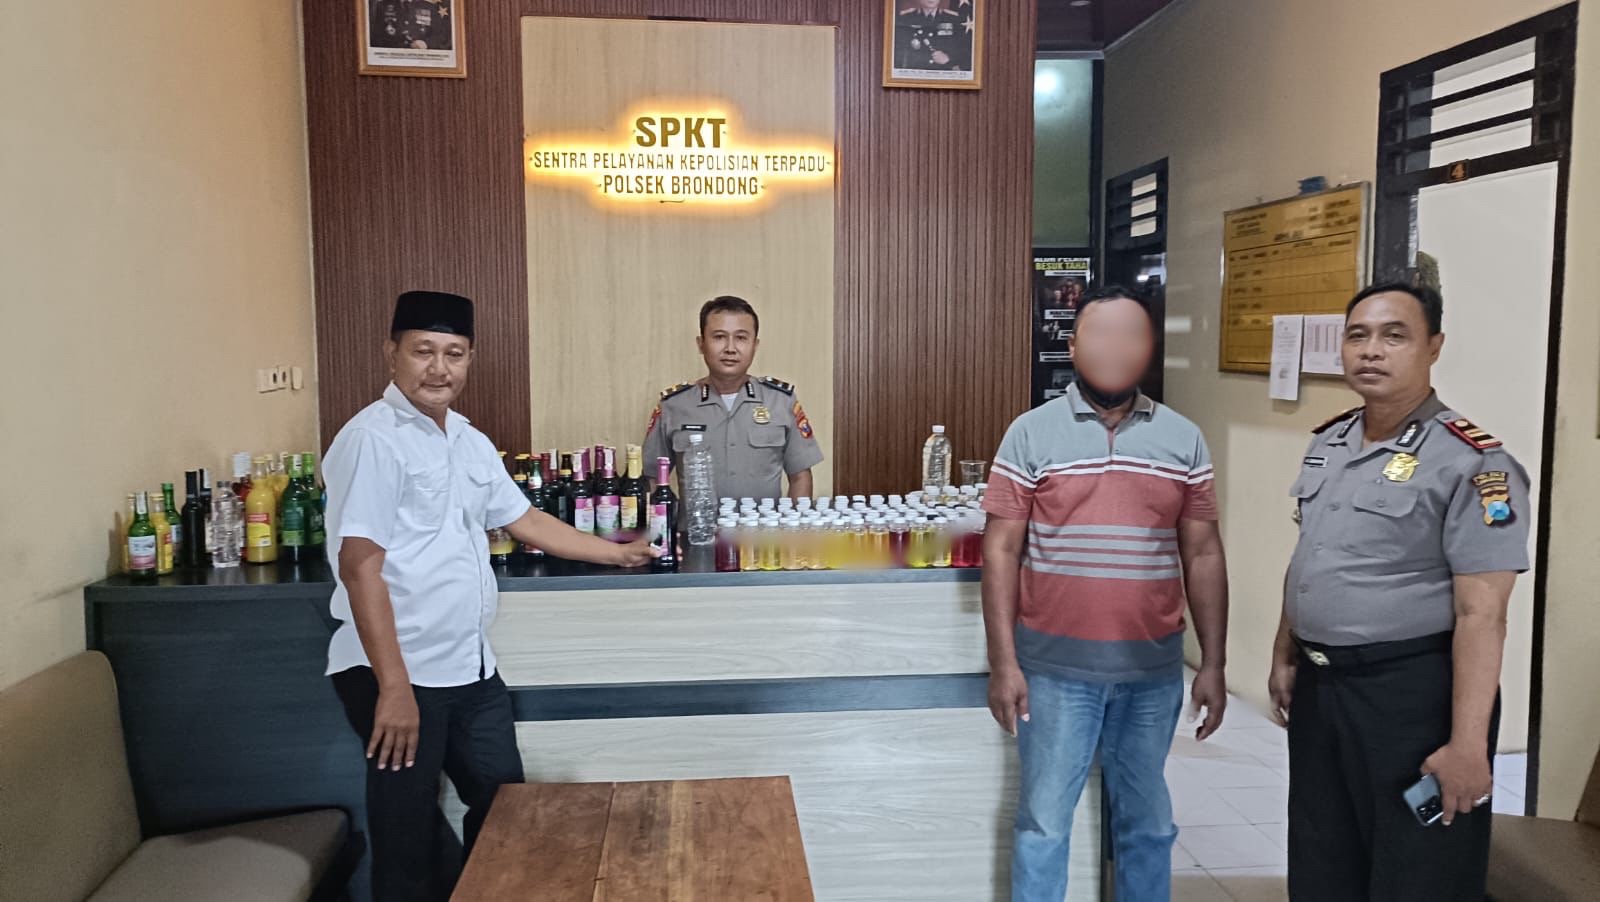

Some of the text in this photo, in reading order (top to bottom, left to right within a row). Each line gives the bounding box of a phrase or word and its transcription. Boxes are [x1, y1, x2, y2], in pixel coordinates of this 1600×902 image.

[636, 117, 726, 148] SPKT
[534, 152, 825, 172] SENTRA PELAYANAN KEPOLISIAN TERPADU
[1451, 163, 1465, 180] 4
[603, 175, 758, 195] POLSEK BRONDONG
